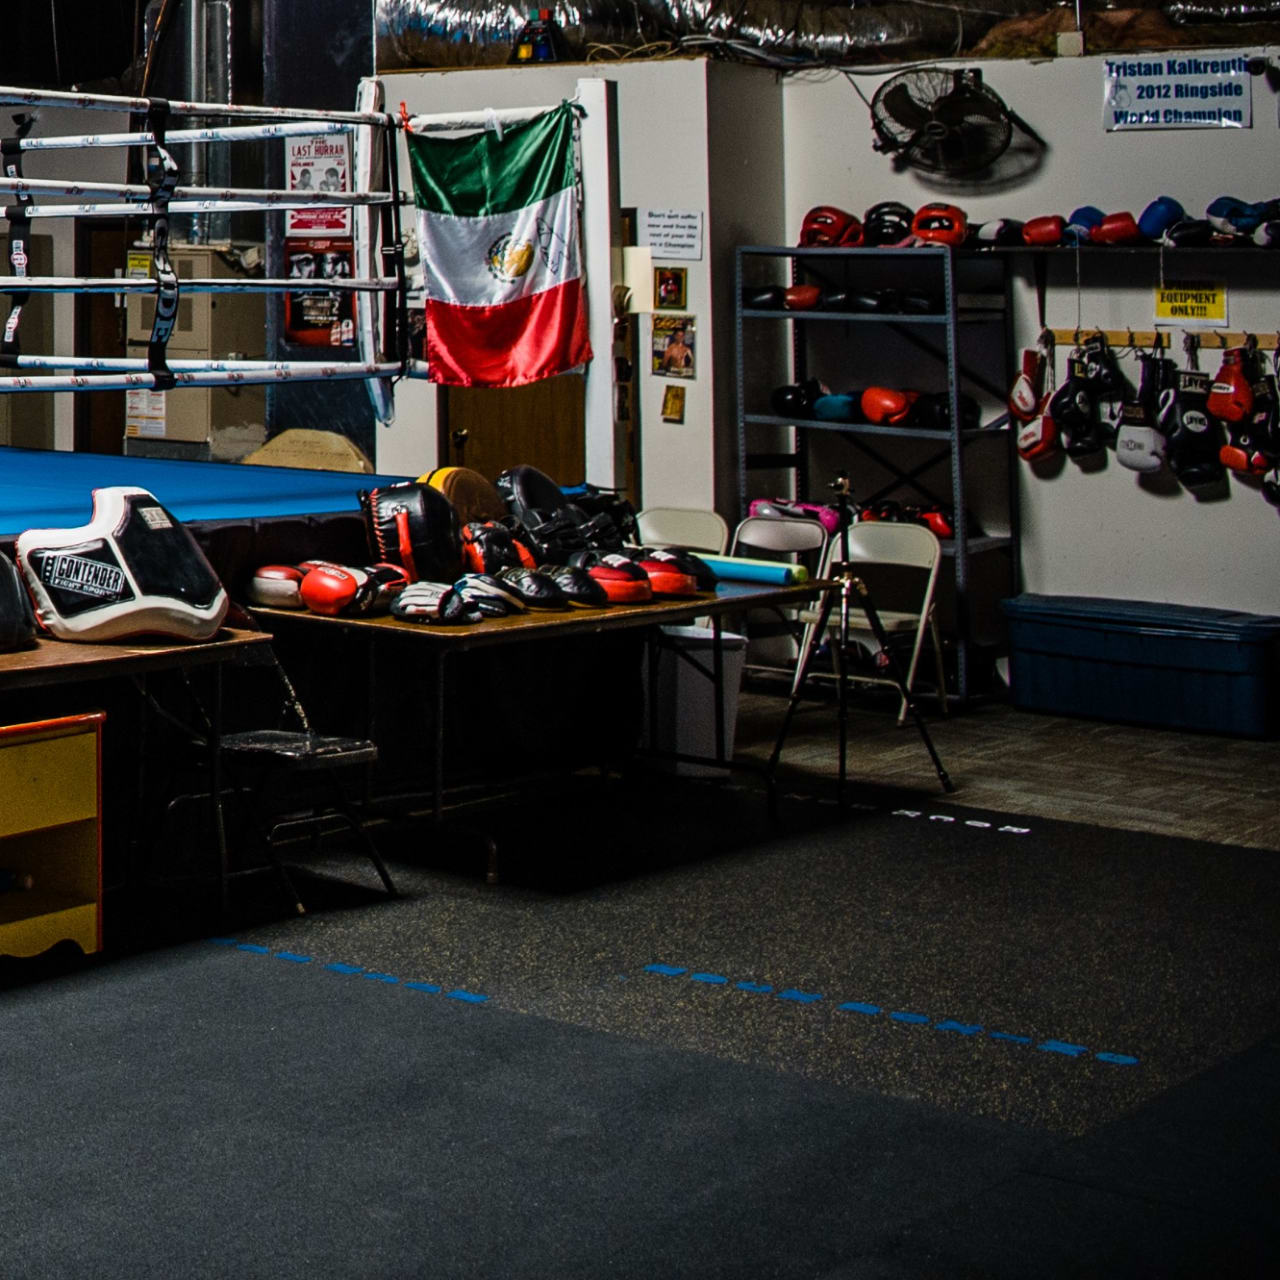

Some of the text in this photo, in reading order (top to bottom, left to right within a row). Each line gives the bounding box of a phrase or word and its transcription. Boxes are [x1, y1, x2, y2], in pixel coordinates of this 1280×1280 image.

[1108, 58, 1249, 78] Tristan Kalkreuth
[1137, 82, 1244, 101] 2012 Ringside
[1114, 108, 1243, 125] World Champion
[291, 144, 345, 157] LAST HURRAH
[1160, 292, 1217, 304] EQUIPMENT
[1170, 305, 1207, 316] ONLY!!!
[58, 557, 121, 591] CONTENDER
[54, 577, 82, 592] FIGHT
